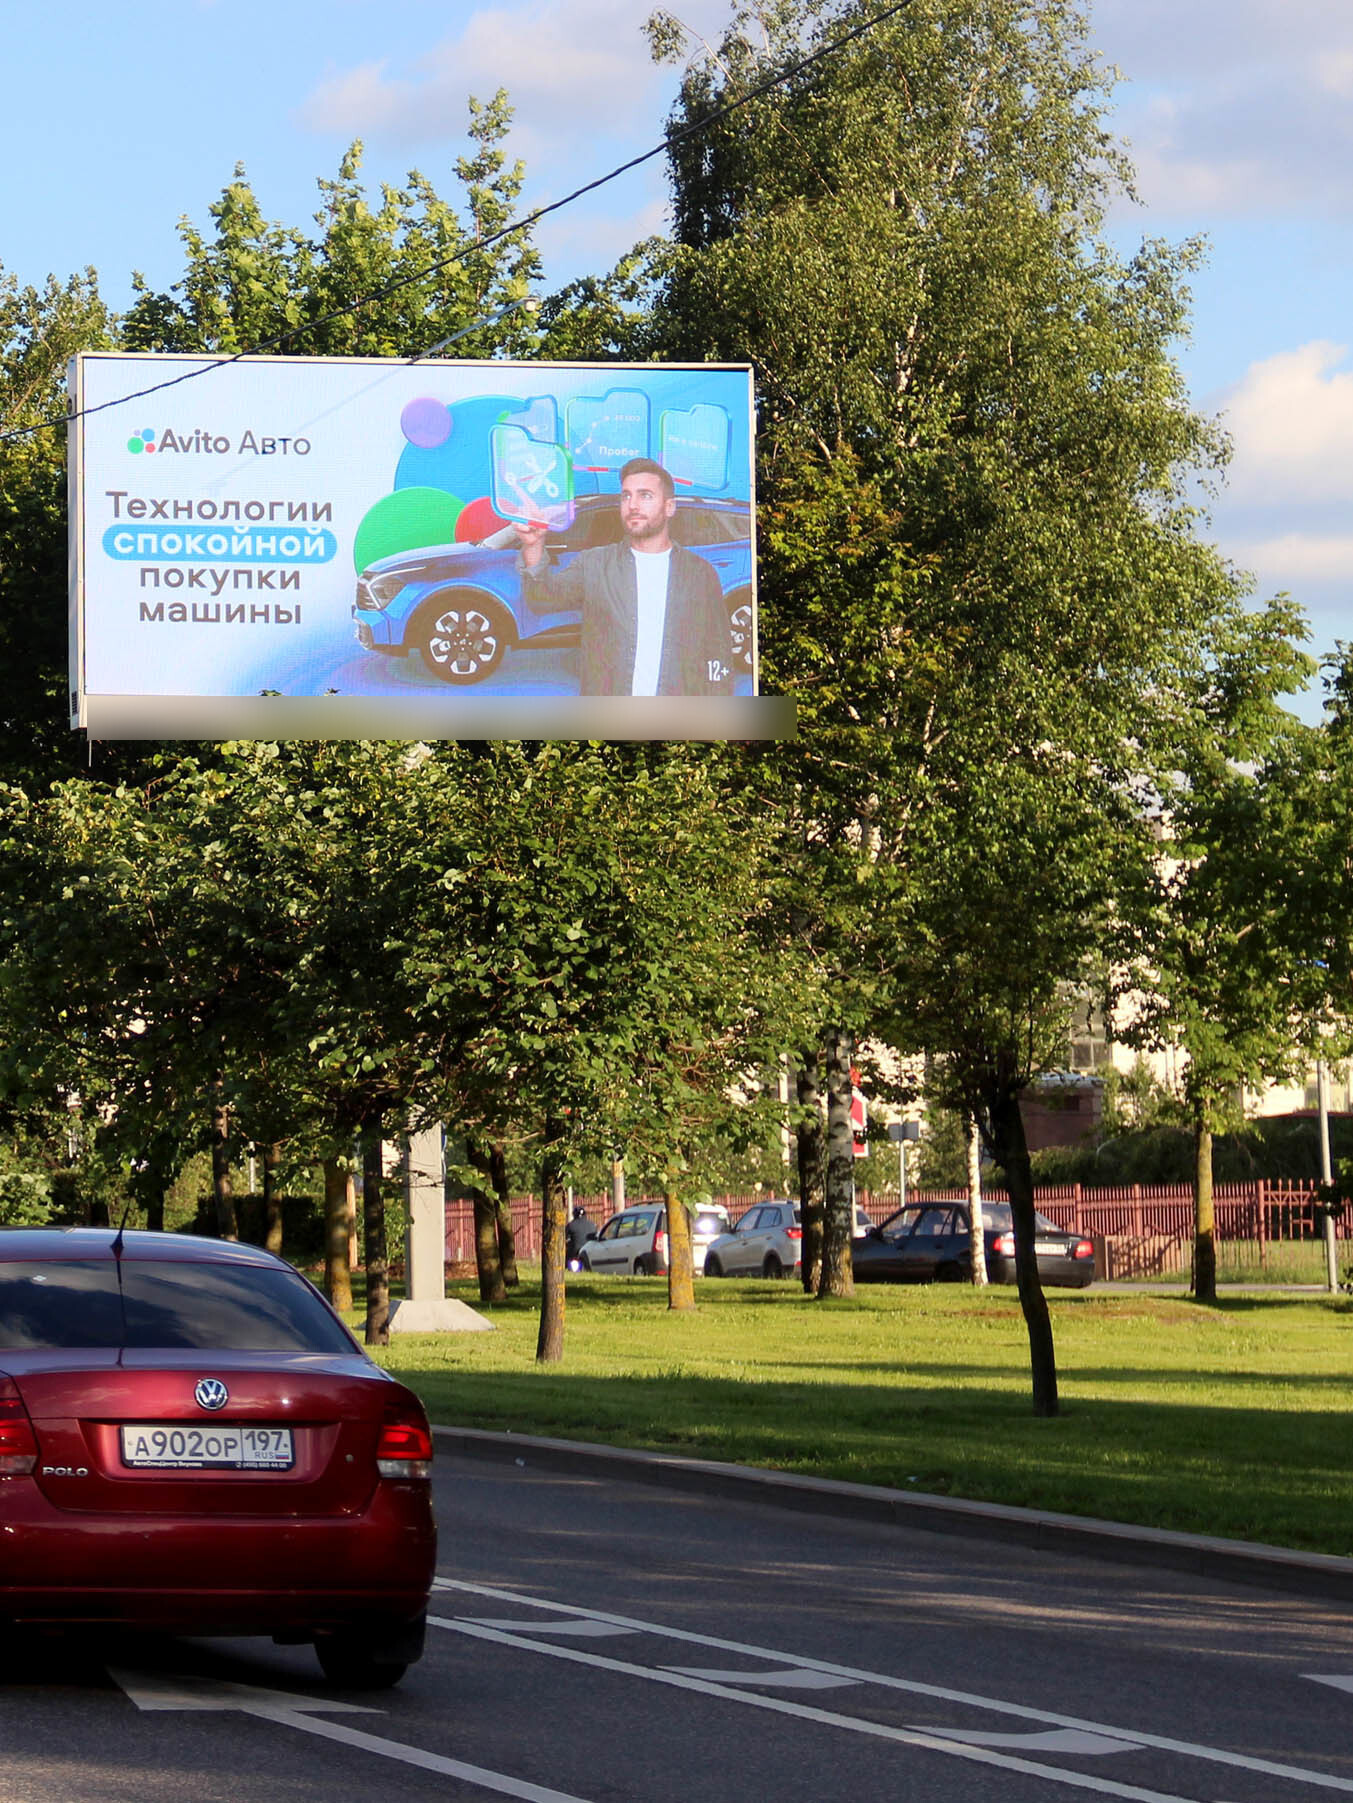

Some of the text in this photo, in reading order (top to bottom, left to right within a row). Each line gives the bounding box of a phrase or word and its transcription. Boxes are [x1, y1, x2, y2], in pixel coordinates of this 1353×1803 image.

[158, 429, 311, 455] Avito Авто
[105, 491, 332, 522] Технологии
[113, 525, 325, 557] спокойной
[140, 567, 300, 596] покупки
[139, 602, 301, 624] машины
[707, 660, 729, 681] 12+
[244, 1430, 284, 1451] 197
[254, 1451, 275, 1460] RUS
[42, 1466, 88, 1477] POLO
